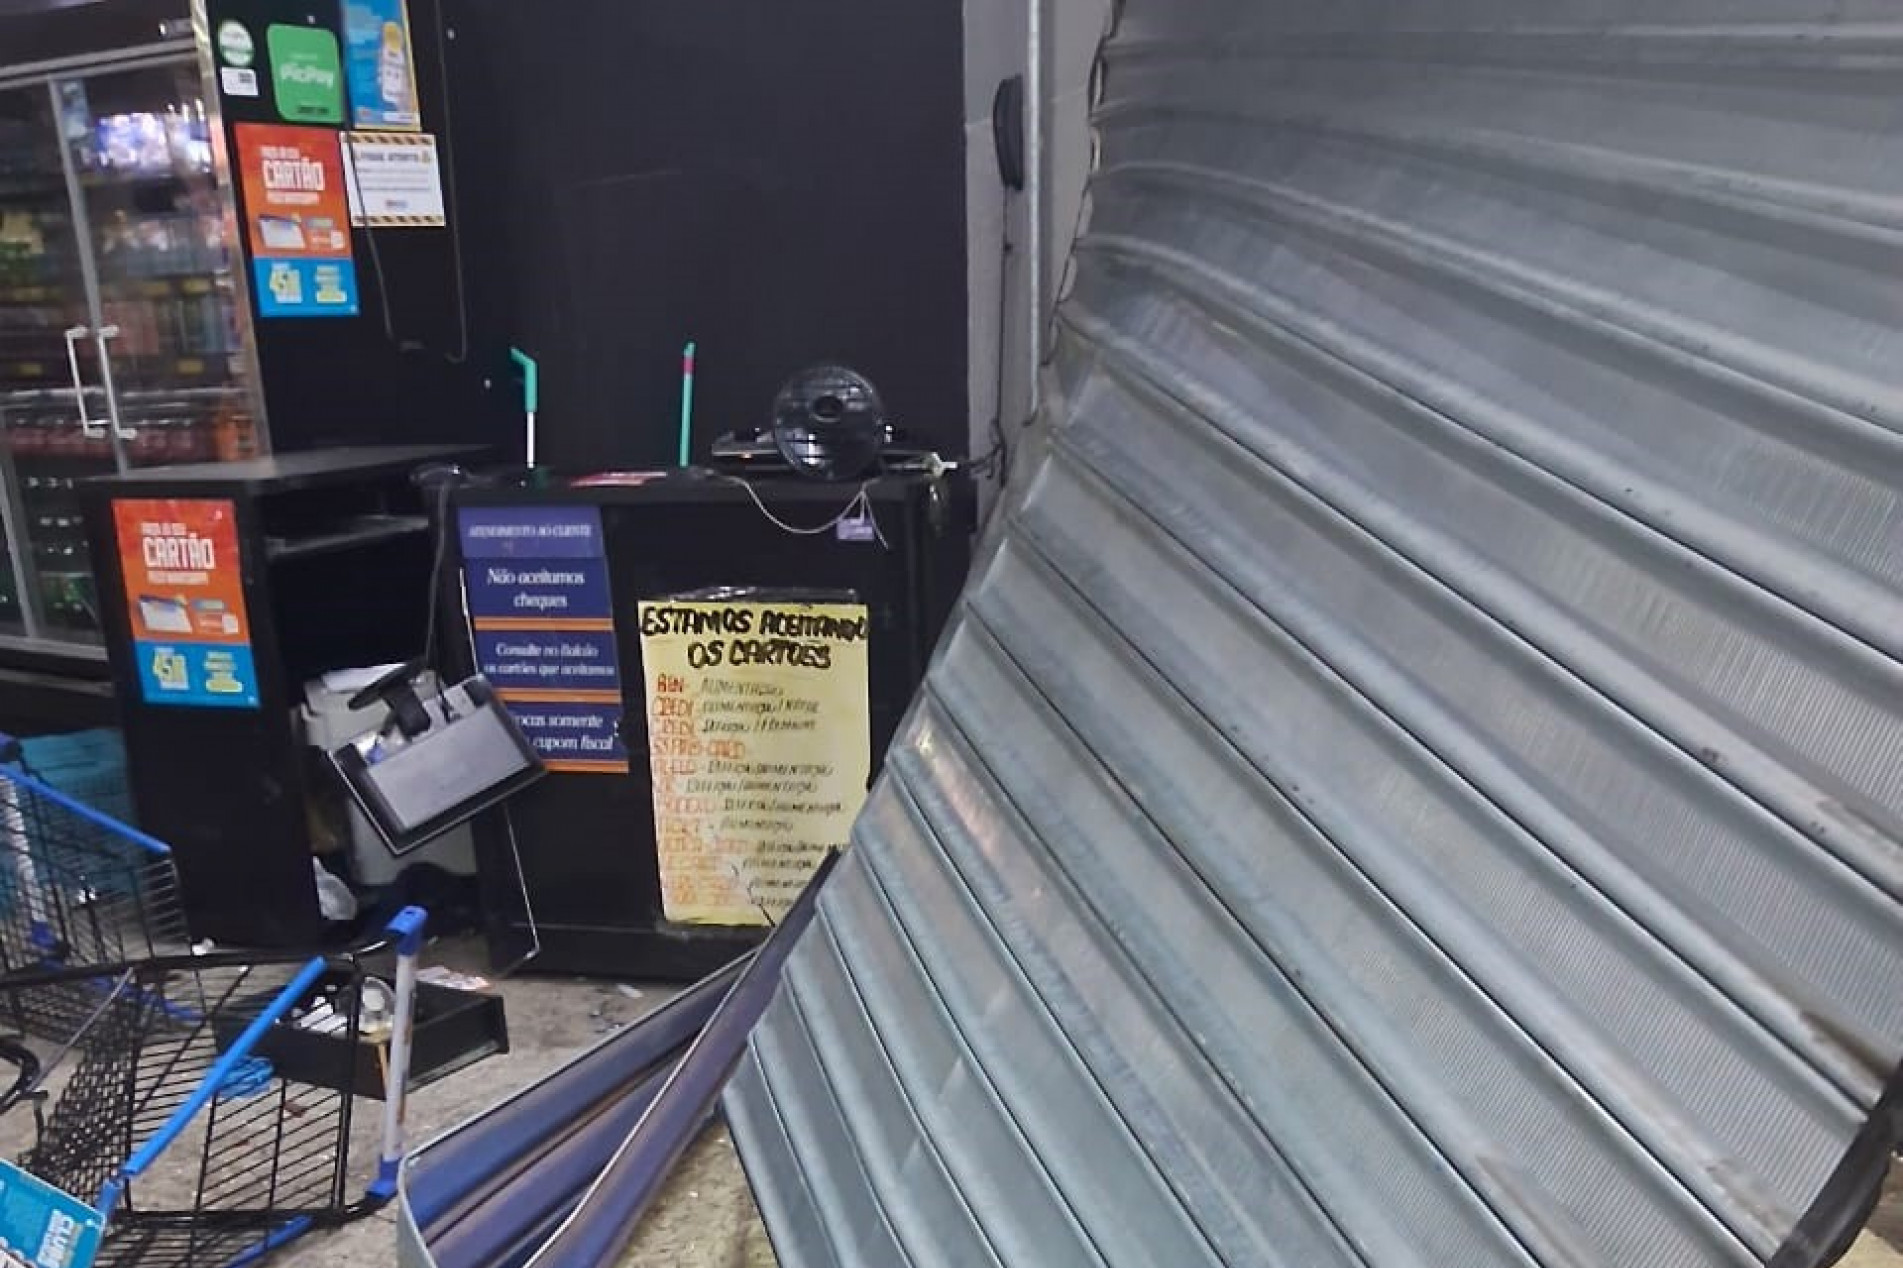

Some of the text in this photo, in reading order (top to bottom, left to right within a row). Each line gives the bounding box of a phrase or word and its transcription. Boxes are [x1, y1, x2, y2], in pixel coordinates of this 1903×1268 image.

[262, 156, 325, 191] CARTÃO
[143, 531, 216, 570] CARTÃO
[487, 567, 585, 586] Não aceitamos
[513, 592, 568, 612] cheques
[641, 606, 754, 637] ESTAMOS
[687, 639, 724, 669] OS
[549, 714, 604, 728] somente
[580, 735, 614, 751] fiscal
